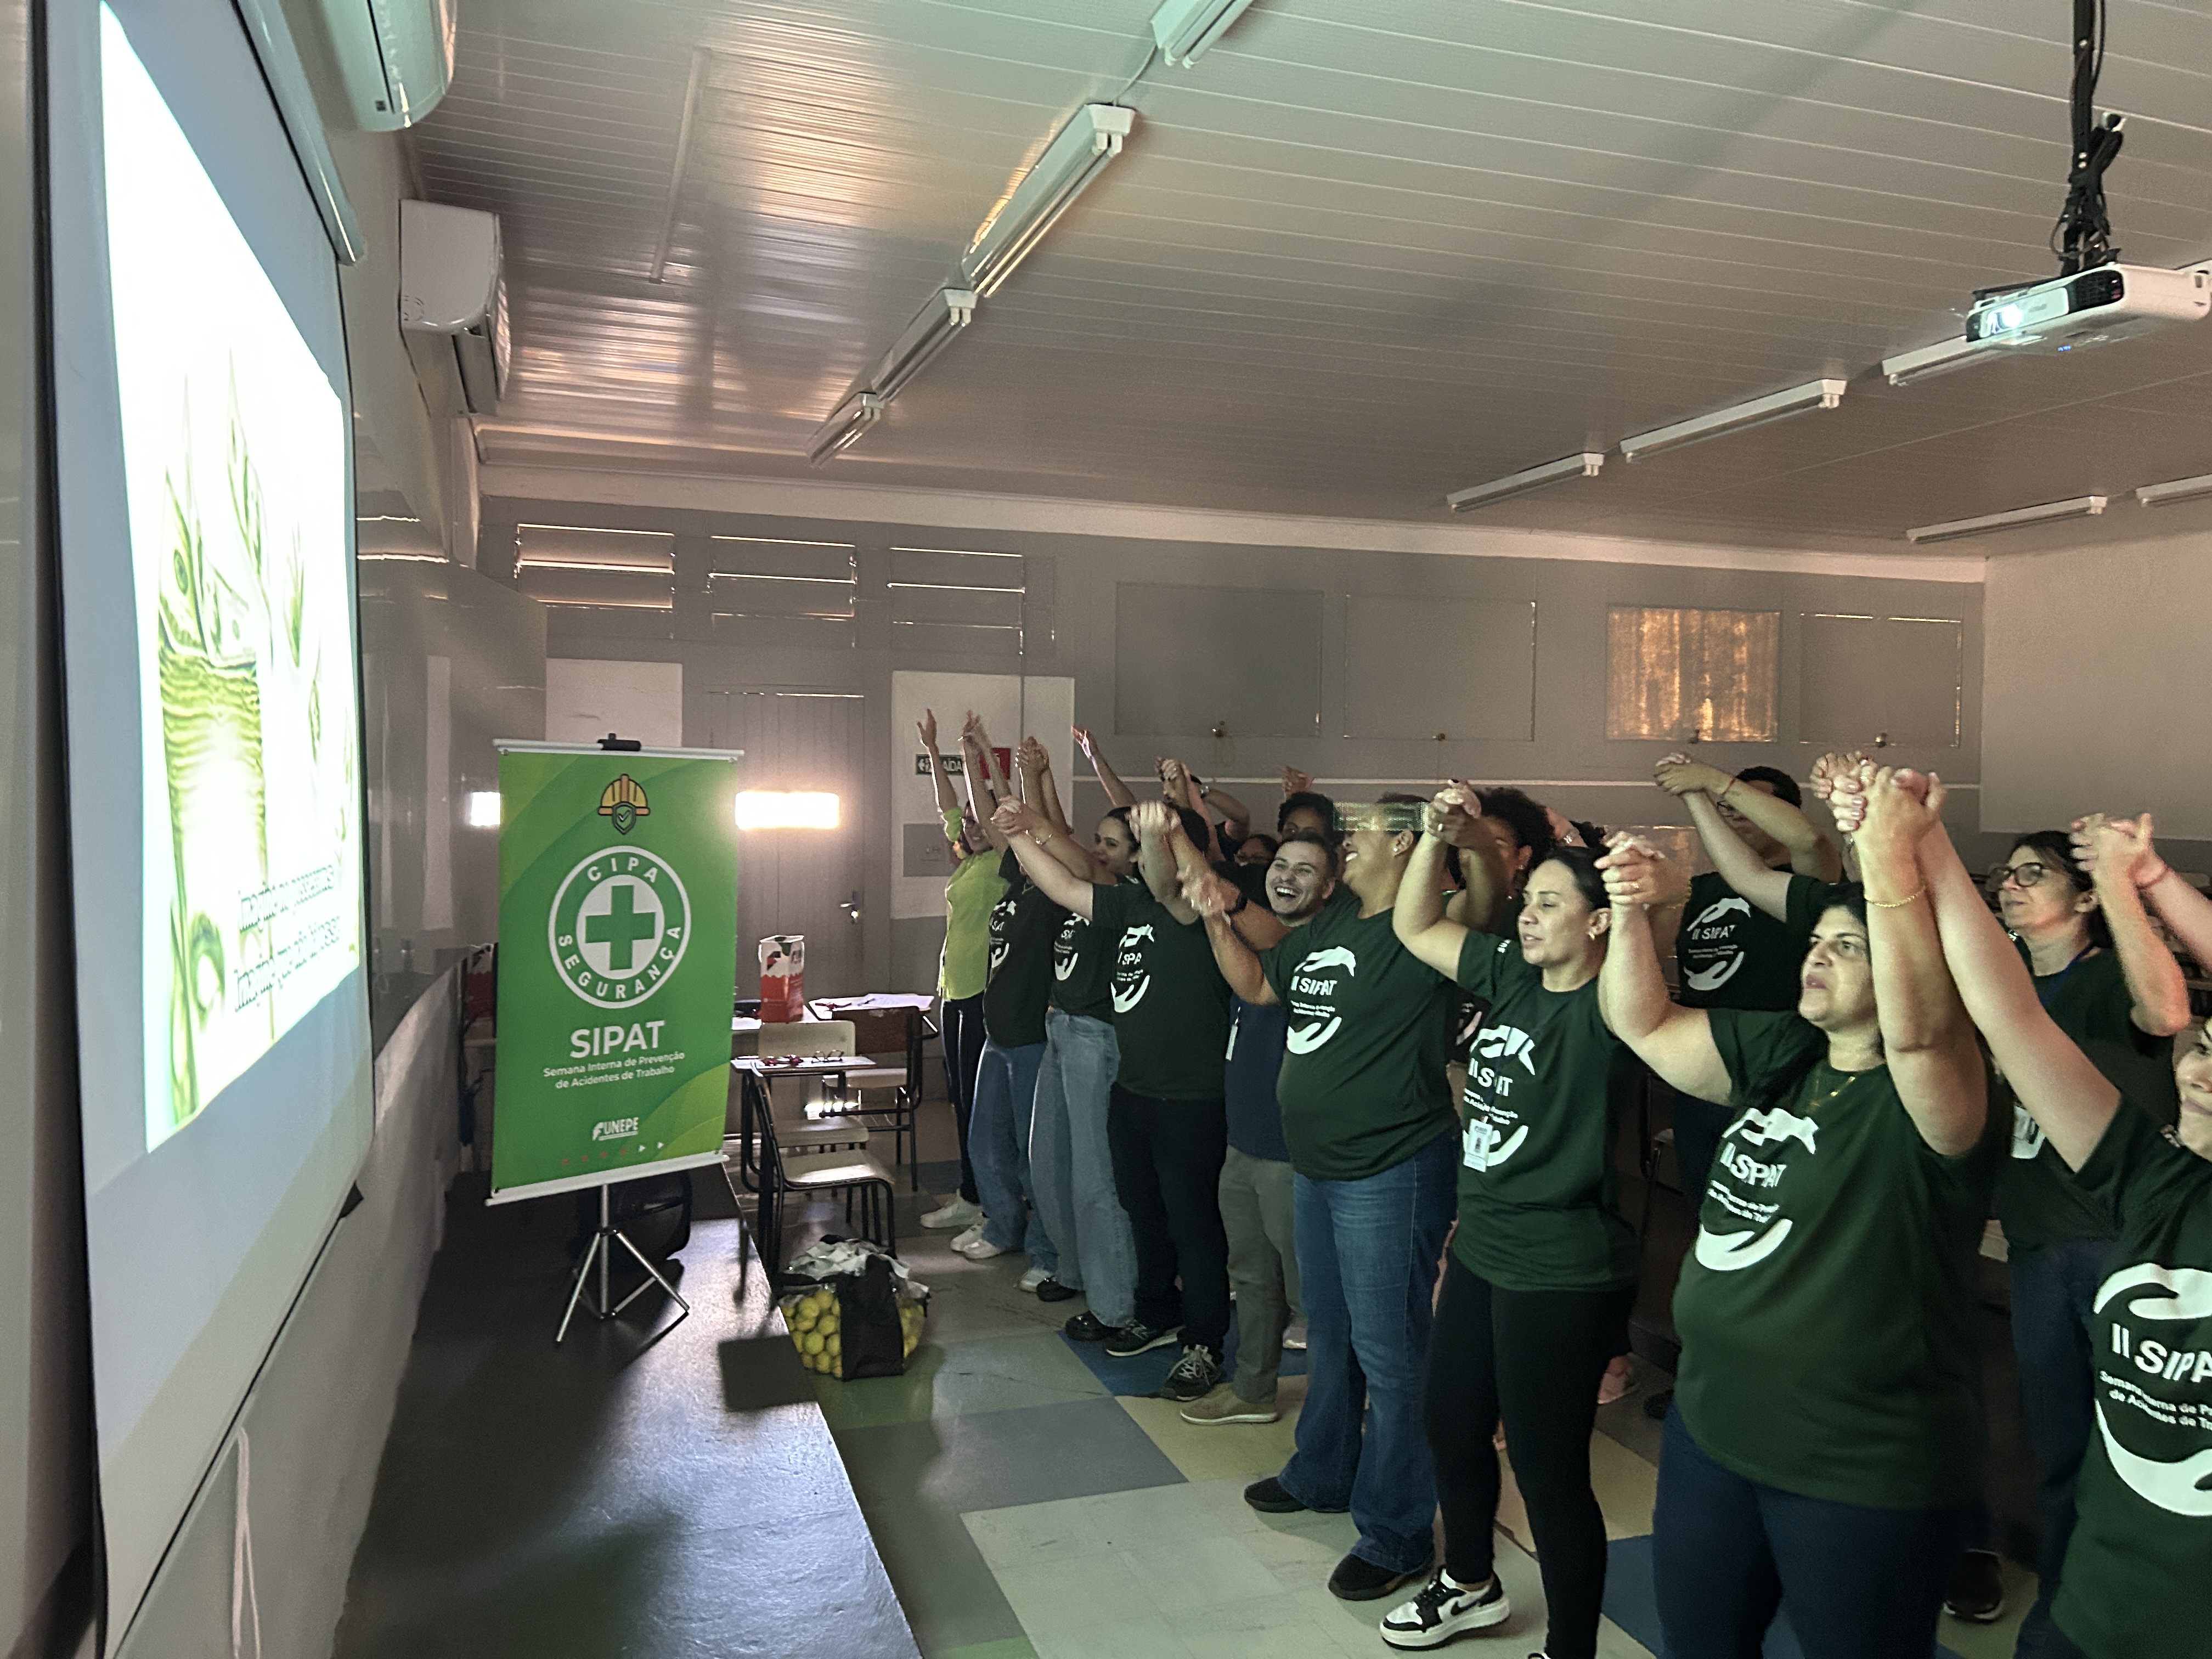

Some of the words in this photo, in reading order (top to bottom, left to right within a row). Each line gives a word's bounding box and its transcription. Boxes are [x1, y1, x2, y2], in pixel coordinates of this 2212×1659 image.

[587, 857, 658, 883] CIPA
[558, 927, 682, 999] SEGURANÇA
[569, 1020, 665, 1058] SIPAT
[543, 1066, 586, 1077] Semana
[587, 1060, 622, 1071] Interna
[624, 1058, 637, 1066] de
[638, 1051, 685, 1064] Prevenção
[555, 1079, 569, 1089] de
[571, 1073, 619, 1087] Acidentes
[620, 1070, 634, 1080] de
[636, 1065, 675, 1078] Trabalho
[2112, 1322, 2130, 1359] II
[2134, 1339, 2212, 1383] SIPA
